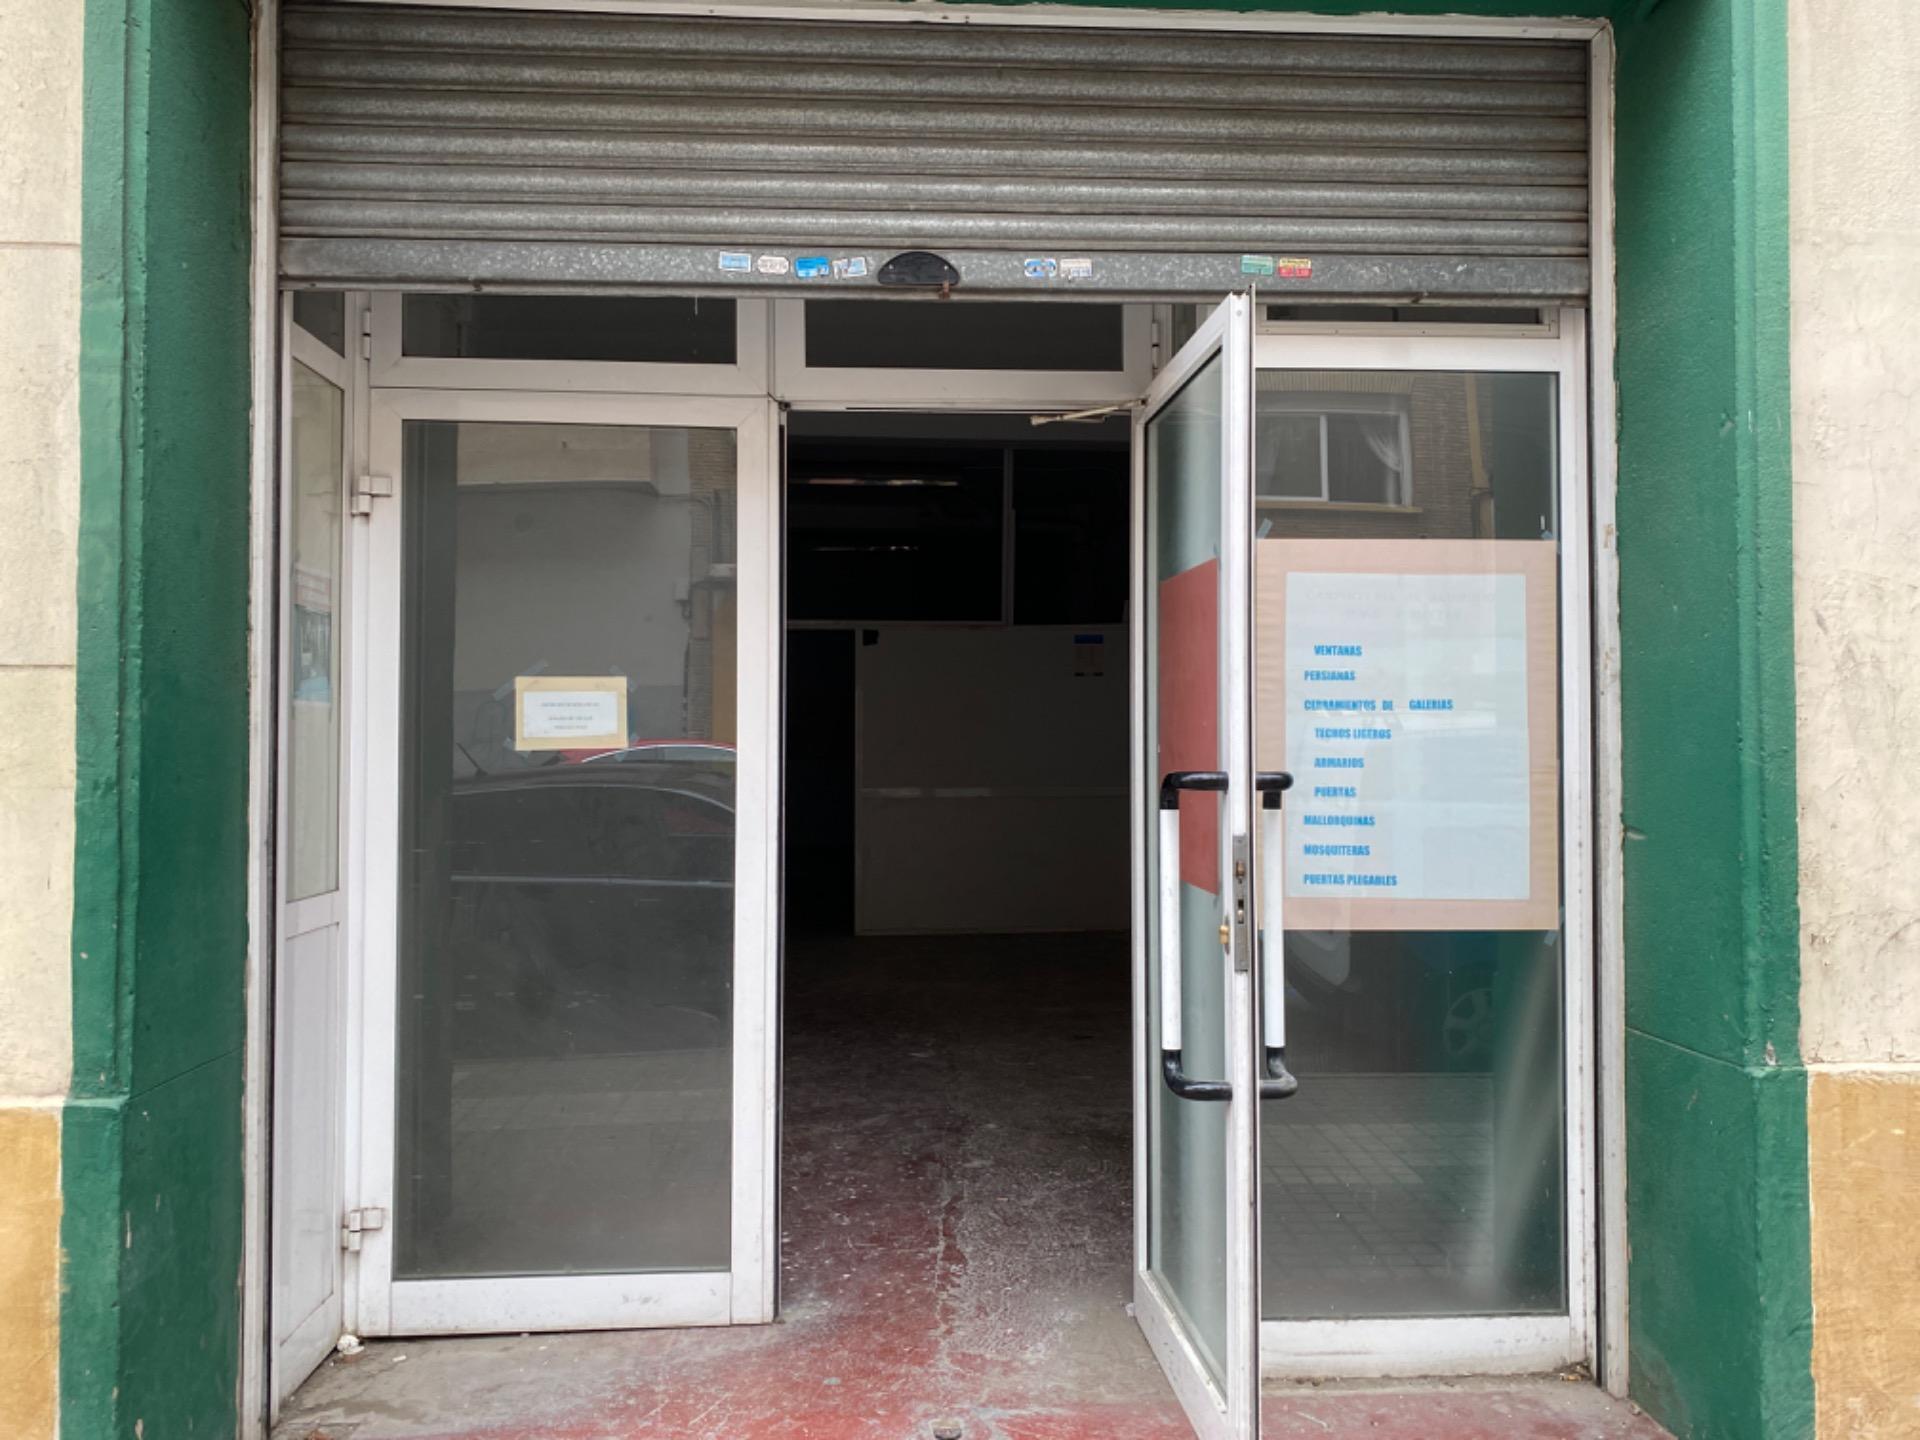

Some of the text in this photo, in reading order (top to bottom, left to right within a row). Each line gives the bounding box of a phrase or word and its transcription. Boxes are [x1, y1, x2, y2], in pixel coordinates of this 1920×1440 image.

[1314, 644, 1363, 657] VENTANAS
[1304, 670, 1356, 682] PERSIANAS
[1382, 700, 1393, 711] DE
[1409, 699, 1454, 711] GALERIAS
[1314, 727, 1352, 740] TECHOS
[1314, 757, 1364, 768] ARMARIOS
[1314, 786, 1356, 798] PUERTAS
[1303, 815, 1375, 828] MALLORQUINAS
[1303, 844, 1371, 857] MOSQUITERAS
[1303, 873, 1398, 886] PUERTAS PLEGABLES
